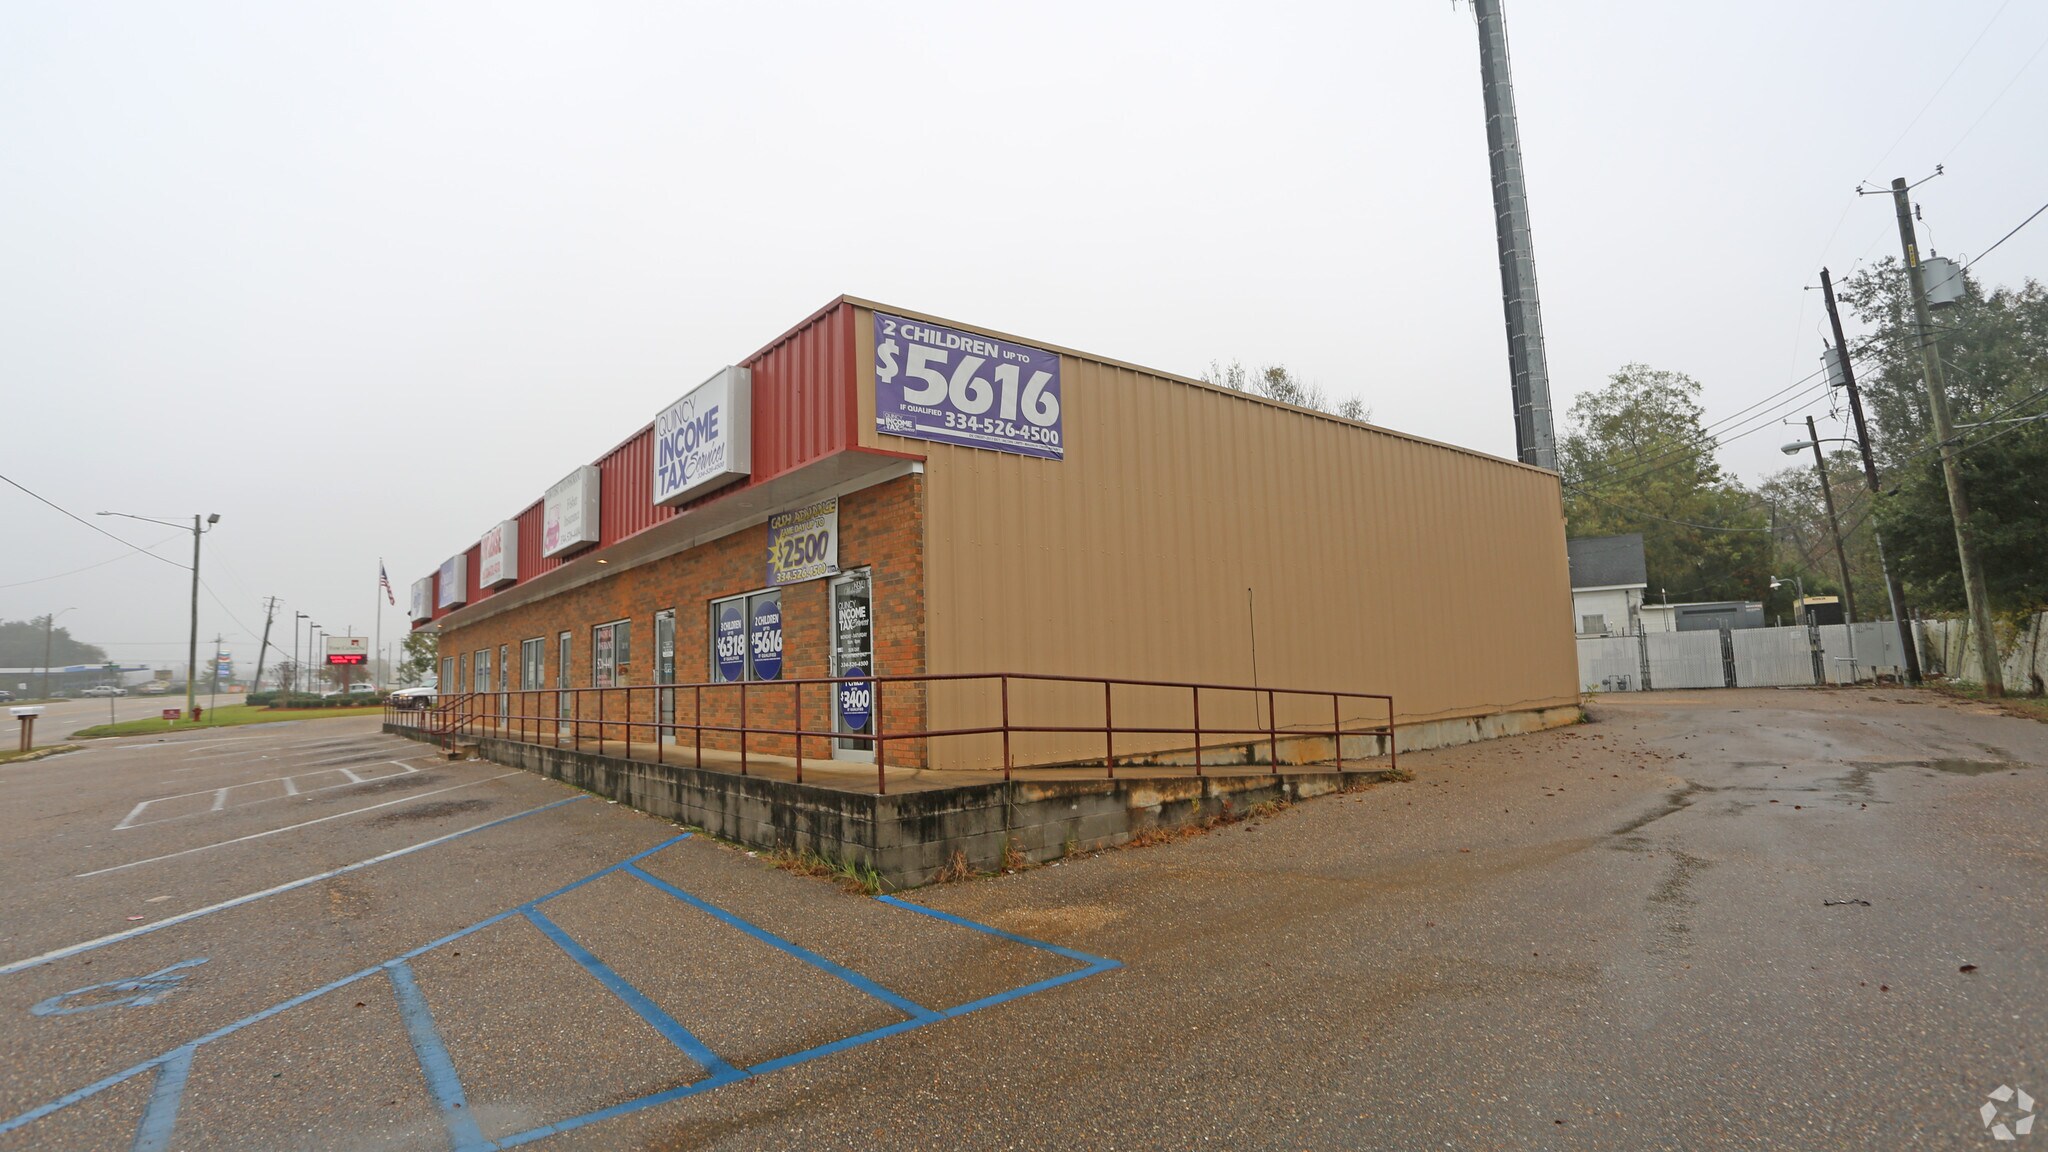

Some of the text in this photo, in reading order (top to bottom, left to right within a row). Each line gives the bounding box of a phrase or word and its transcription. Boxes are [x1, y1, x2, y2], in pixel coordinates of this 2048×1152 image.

[883, 319, 1030, 363] 2 CHILDREN UP TO
[876, 338, 1060, 427] $5616
[659, 395, 696, 437] QUINCY
[900, 403, 942, 417] IF QUALIFIED
[659, 405, 719, 467] INCOME
[945, 411, 1059, 445] 334-526-4500
[658, 456, 688, 496] TAX
[771, 497, 836, 529] CASH ADVANCE
[778, 531, 829, 568] $2500
[724, 619, 742, 631] CHILDREN
[758, 613, 779, 626] CHILDREN
[839, 606, 866, 620] INCOME
[839, 619, 853, 631] TAX
[717, 634, 745, 657] $6318
[752, 629, 782, 654] $5616
[840, 689, 870, 709] $3400
